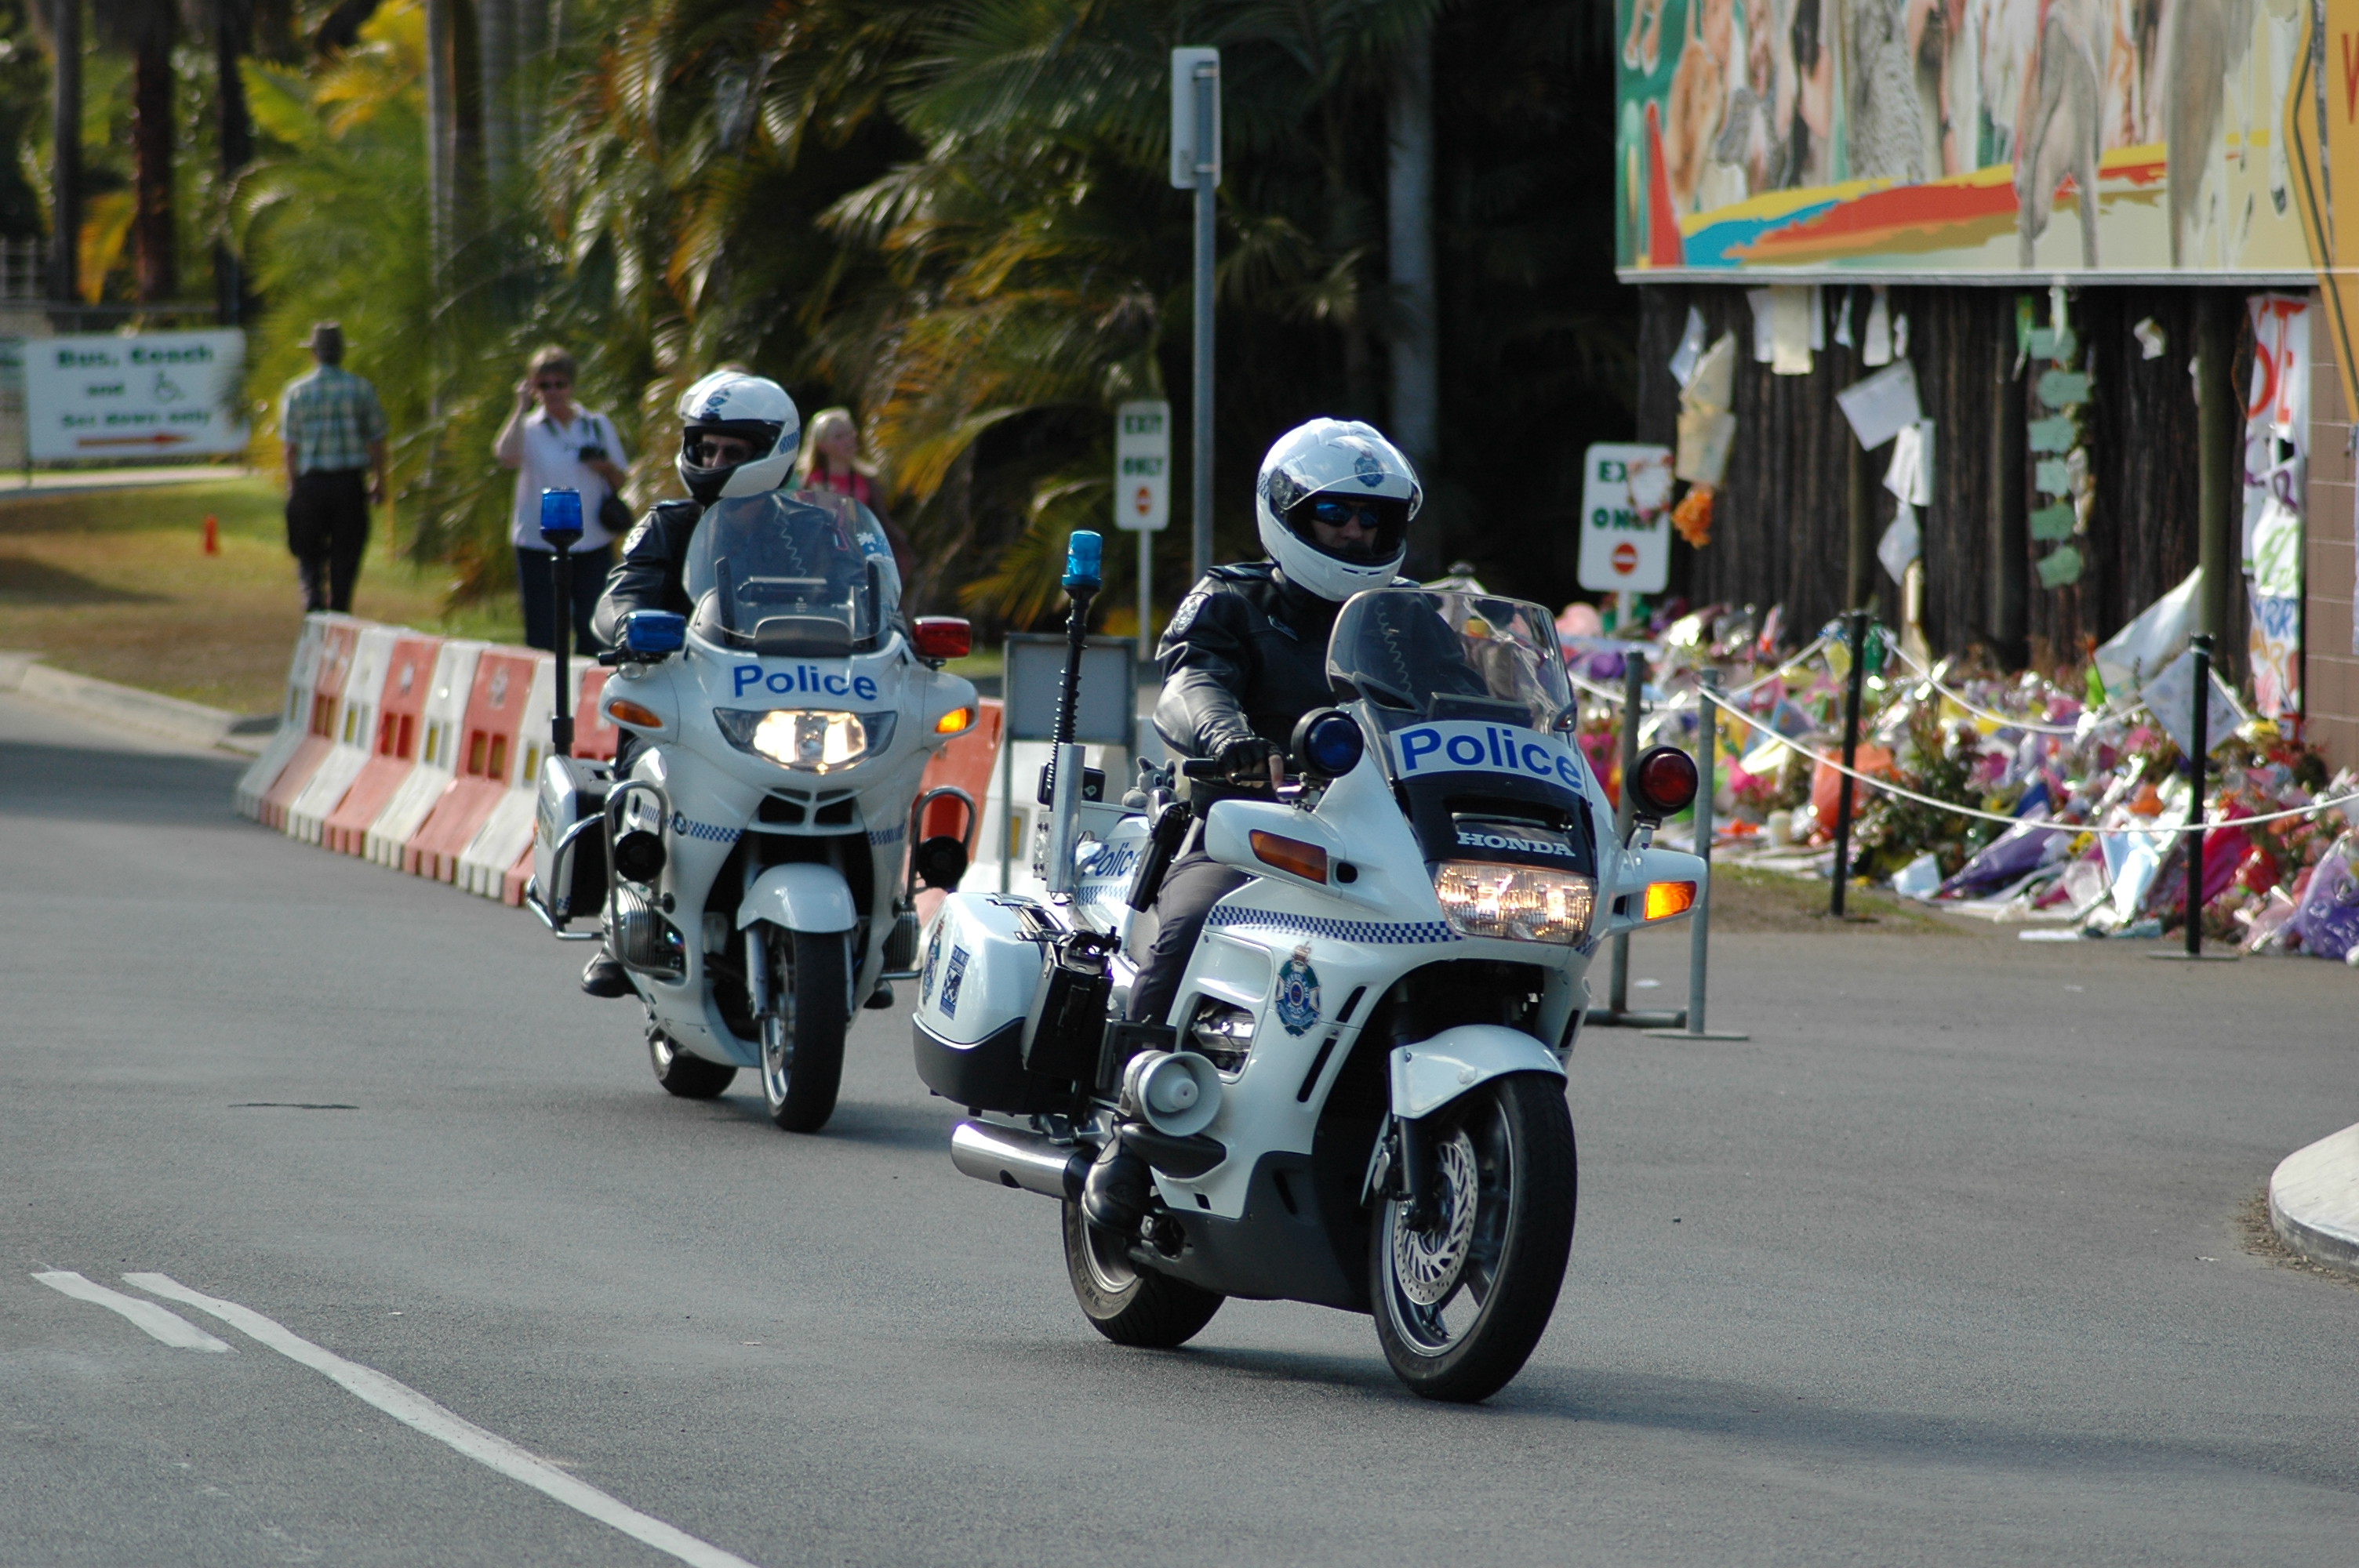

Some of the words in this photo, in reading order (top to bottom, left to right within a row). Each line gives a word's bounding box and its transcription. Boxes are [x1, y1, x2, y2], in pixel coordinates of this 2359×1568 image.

[131, 346, 214, 365] Coach
[733, 664, 878, 701] Police
[1400, 726, 1583, 789] Police
[1457, 832, 1576, 857] HONDA
